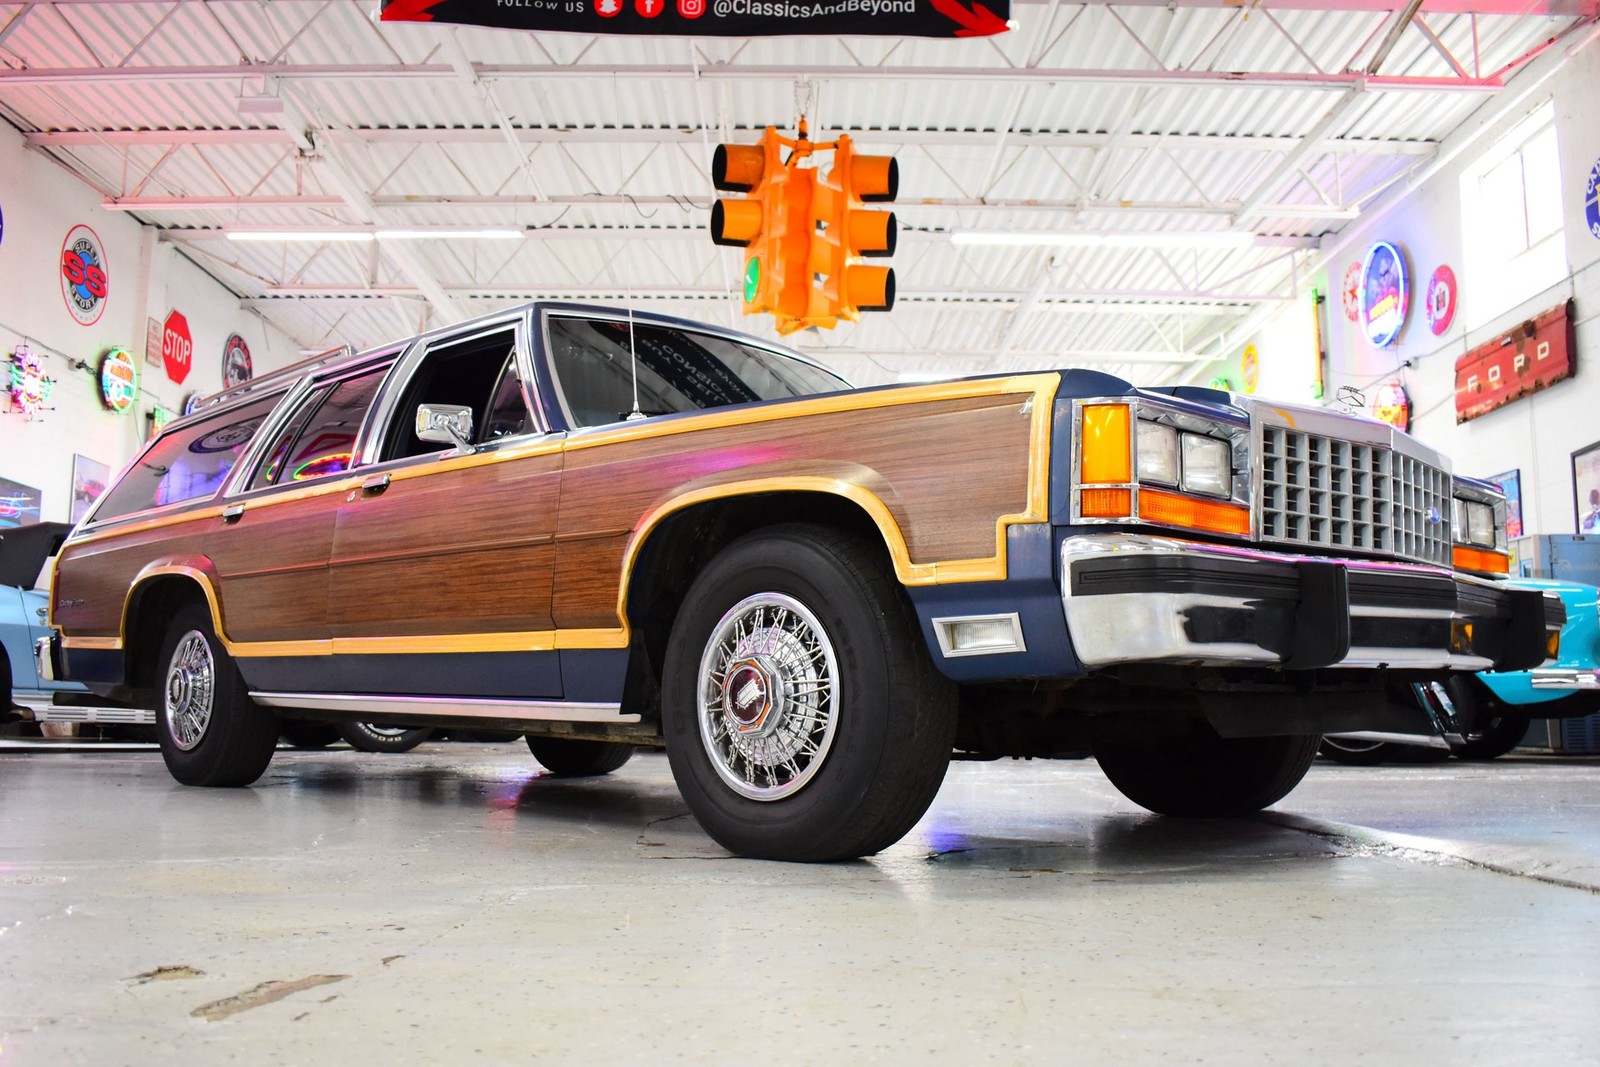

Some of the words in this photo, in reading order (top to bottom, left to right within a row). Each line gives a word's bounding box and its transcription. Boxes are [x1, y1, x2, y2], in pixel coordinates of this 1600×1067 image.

[565, 2, 584, 13] US
[713, 0, 915, 18] @ClassicsAndBeyond
[63, 250, 106, 298] SS
[164, 328, 190, 365] STOP
[1467, 341, 1550, 393] FORD
